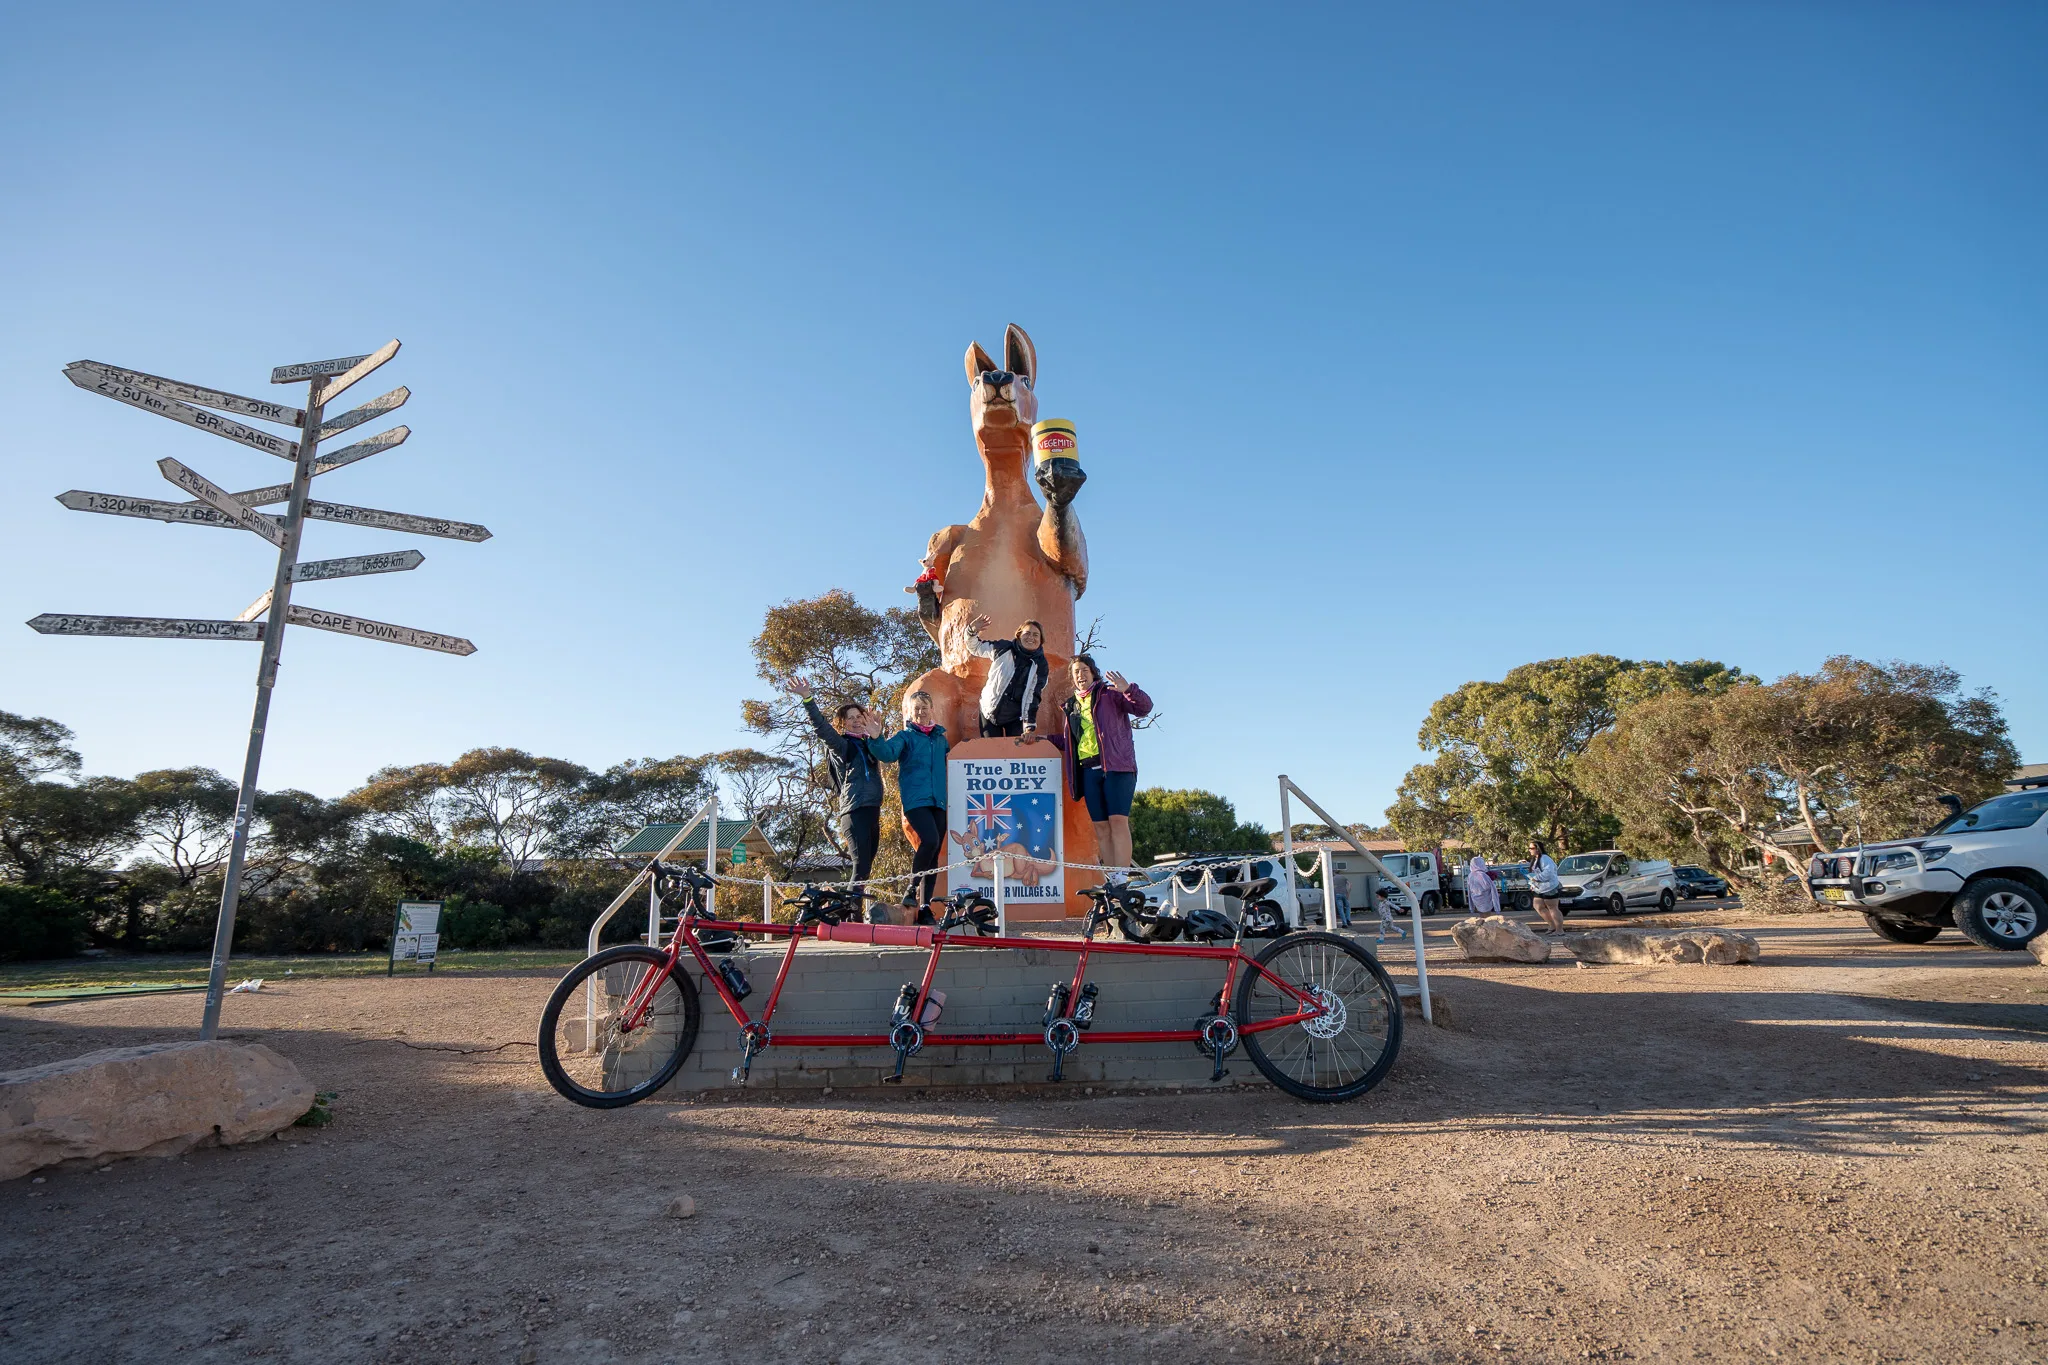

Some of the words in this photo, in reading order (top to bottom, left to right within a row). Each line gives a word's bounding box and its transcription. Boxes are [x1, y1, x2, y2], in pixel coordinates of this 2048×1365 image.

[301, 362, 335, 375] BORDER
[1039, 438, 1073, 449] VEGEMITE
[204, 485, 218, 502] km
[241, 508, 277, 538] DARWIN
[390, 557, 405, 567] km
[310, 612, 352, 631] CAPE
[355, 621, 399, 640] TOWN
[963, 763, 1003, 776] True
[1009, 762, 1047, 775] Blue
[966, 777, 1047, 791] ROOEY
[1012, 885, 1044, 898] VILLAGE
[1045, 885, 1061, 898] S.A.
